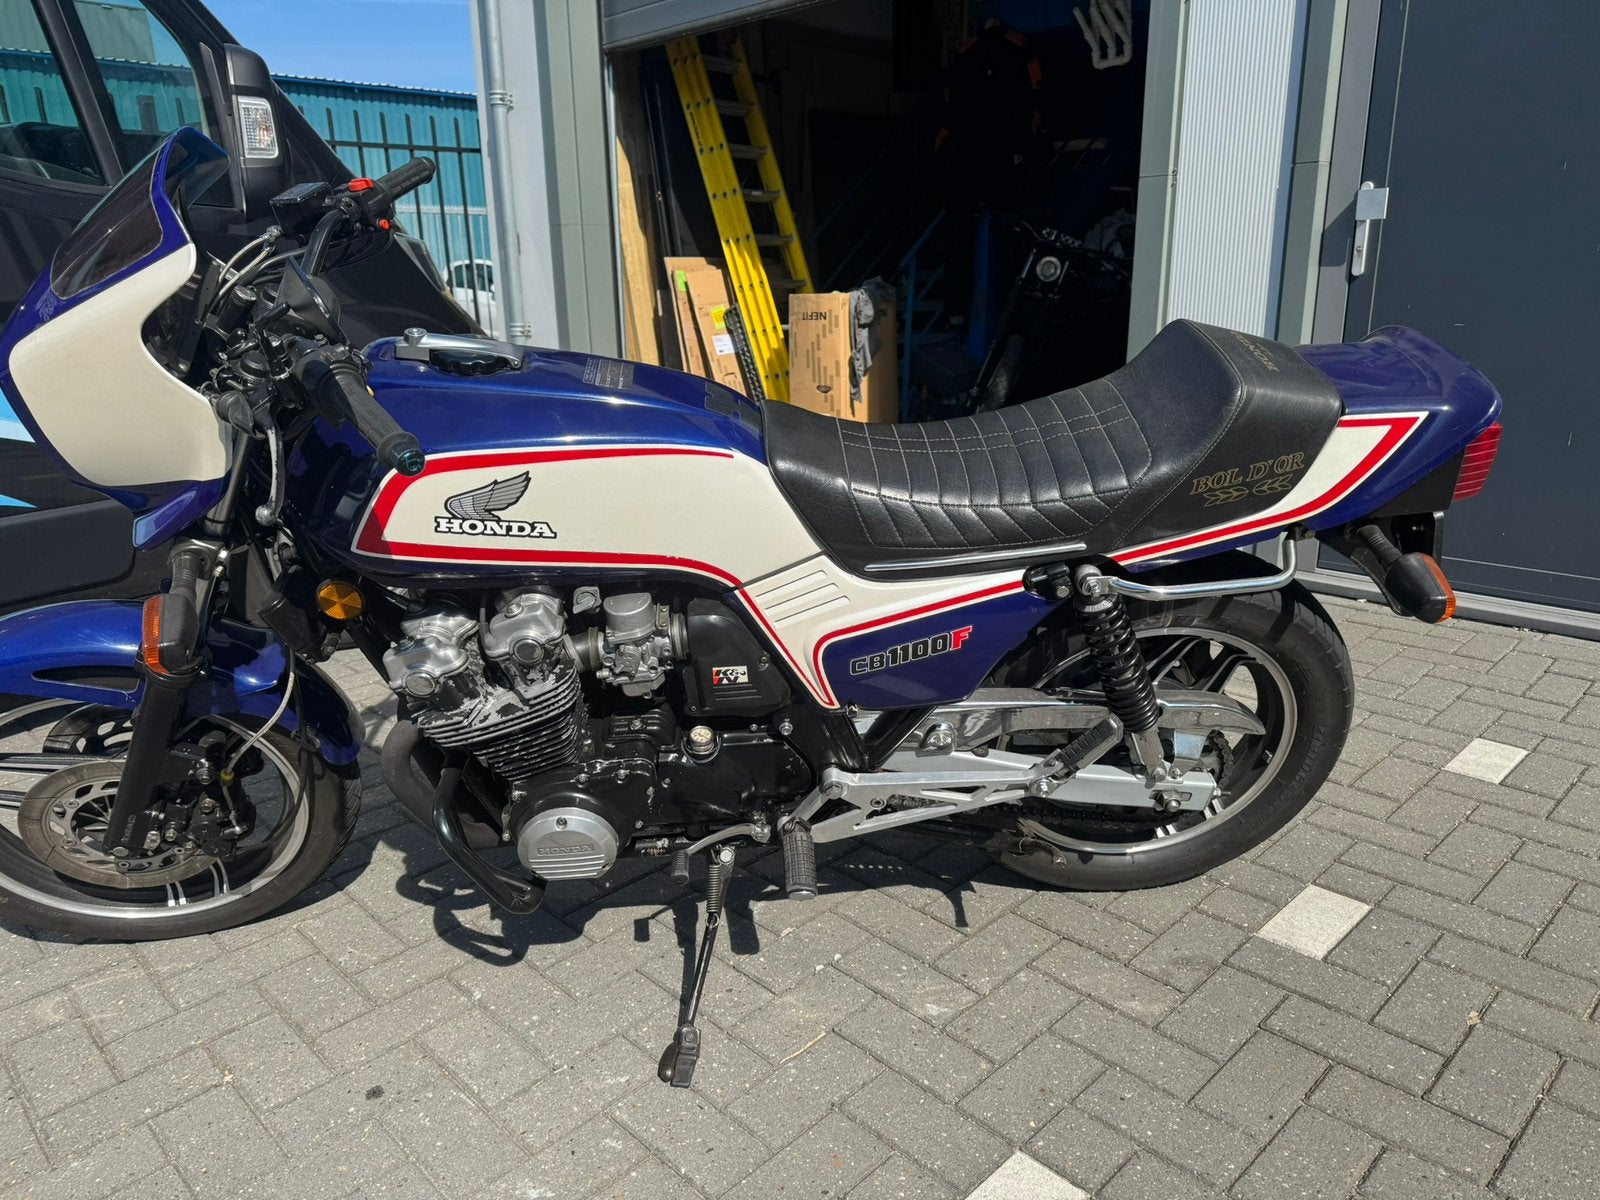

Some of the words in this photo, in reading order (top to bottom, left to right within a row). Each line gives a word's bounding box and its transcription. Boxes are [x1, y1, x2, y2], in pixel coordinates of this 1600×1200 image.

[802, 311, 827, 321] NEFIT
[1189, 467, 1243, 495] BOL
[1246, 451, 1305, 482] D'OR
[435, 517, 557, 538] HONDA
[849, 625, 974, 675] CB1100F
[537, 845, 594, 855] HONDA
